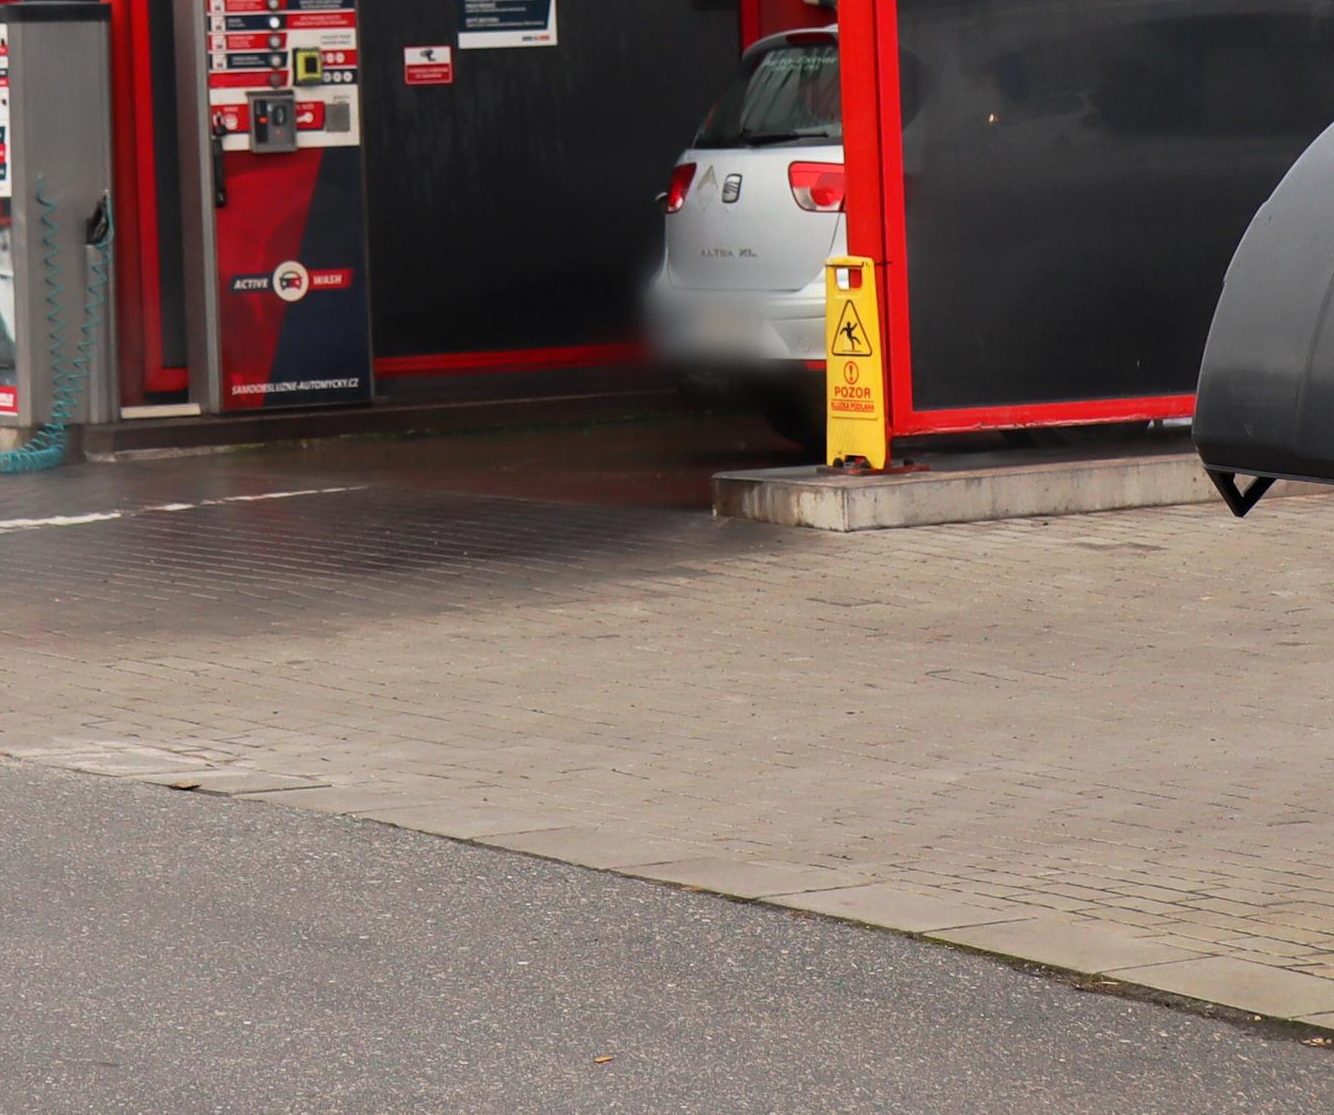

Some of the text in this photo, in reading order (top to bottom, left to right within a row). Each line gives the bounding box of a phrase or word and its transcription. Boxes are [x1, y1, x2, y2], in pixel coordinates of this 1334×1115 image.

[233, 274, 343, 290] ACTIVE WASH
[834, 386, 871, 399] POZOR
